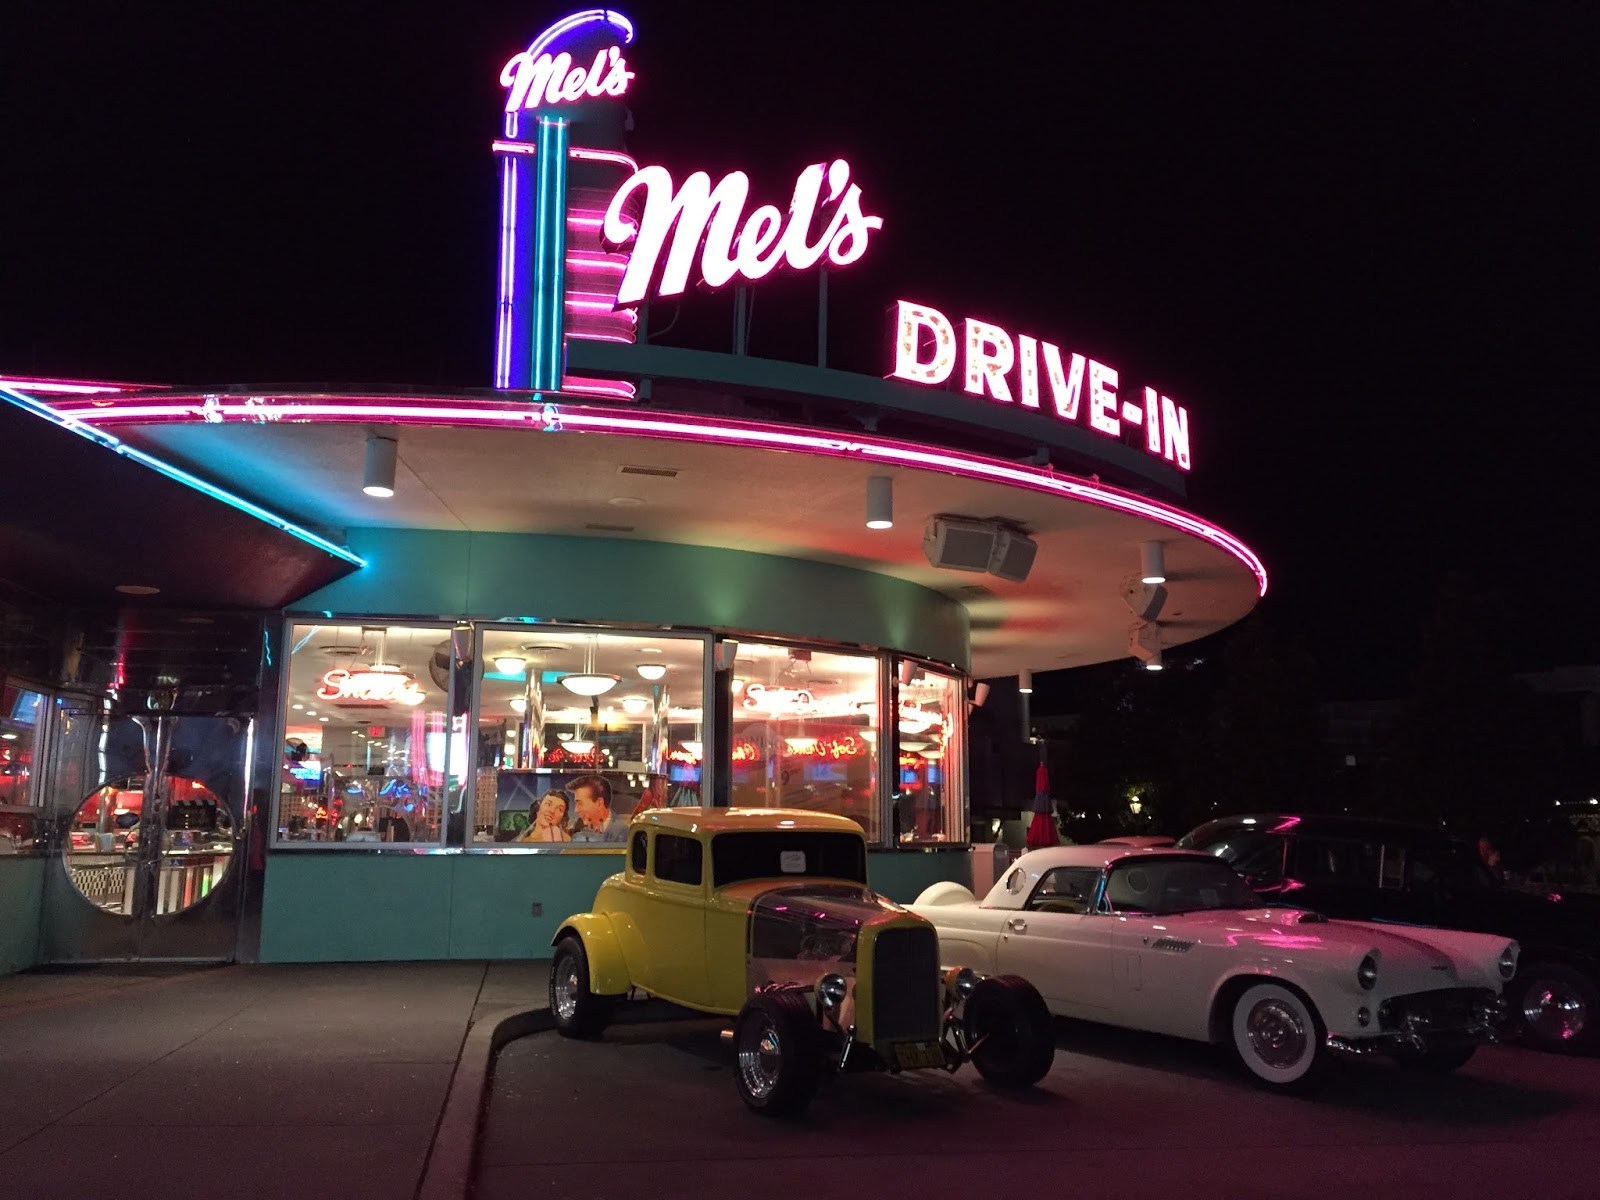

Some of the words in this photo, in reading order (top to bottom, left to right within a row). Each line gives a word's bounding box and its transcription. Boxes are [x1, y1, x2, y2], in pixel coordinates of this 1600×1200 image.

[499, 44, 636, 113] Mel's
[602, 158, 884, 309] Mel's
[891, 299, 1192, 472] DRIVE-IN
